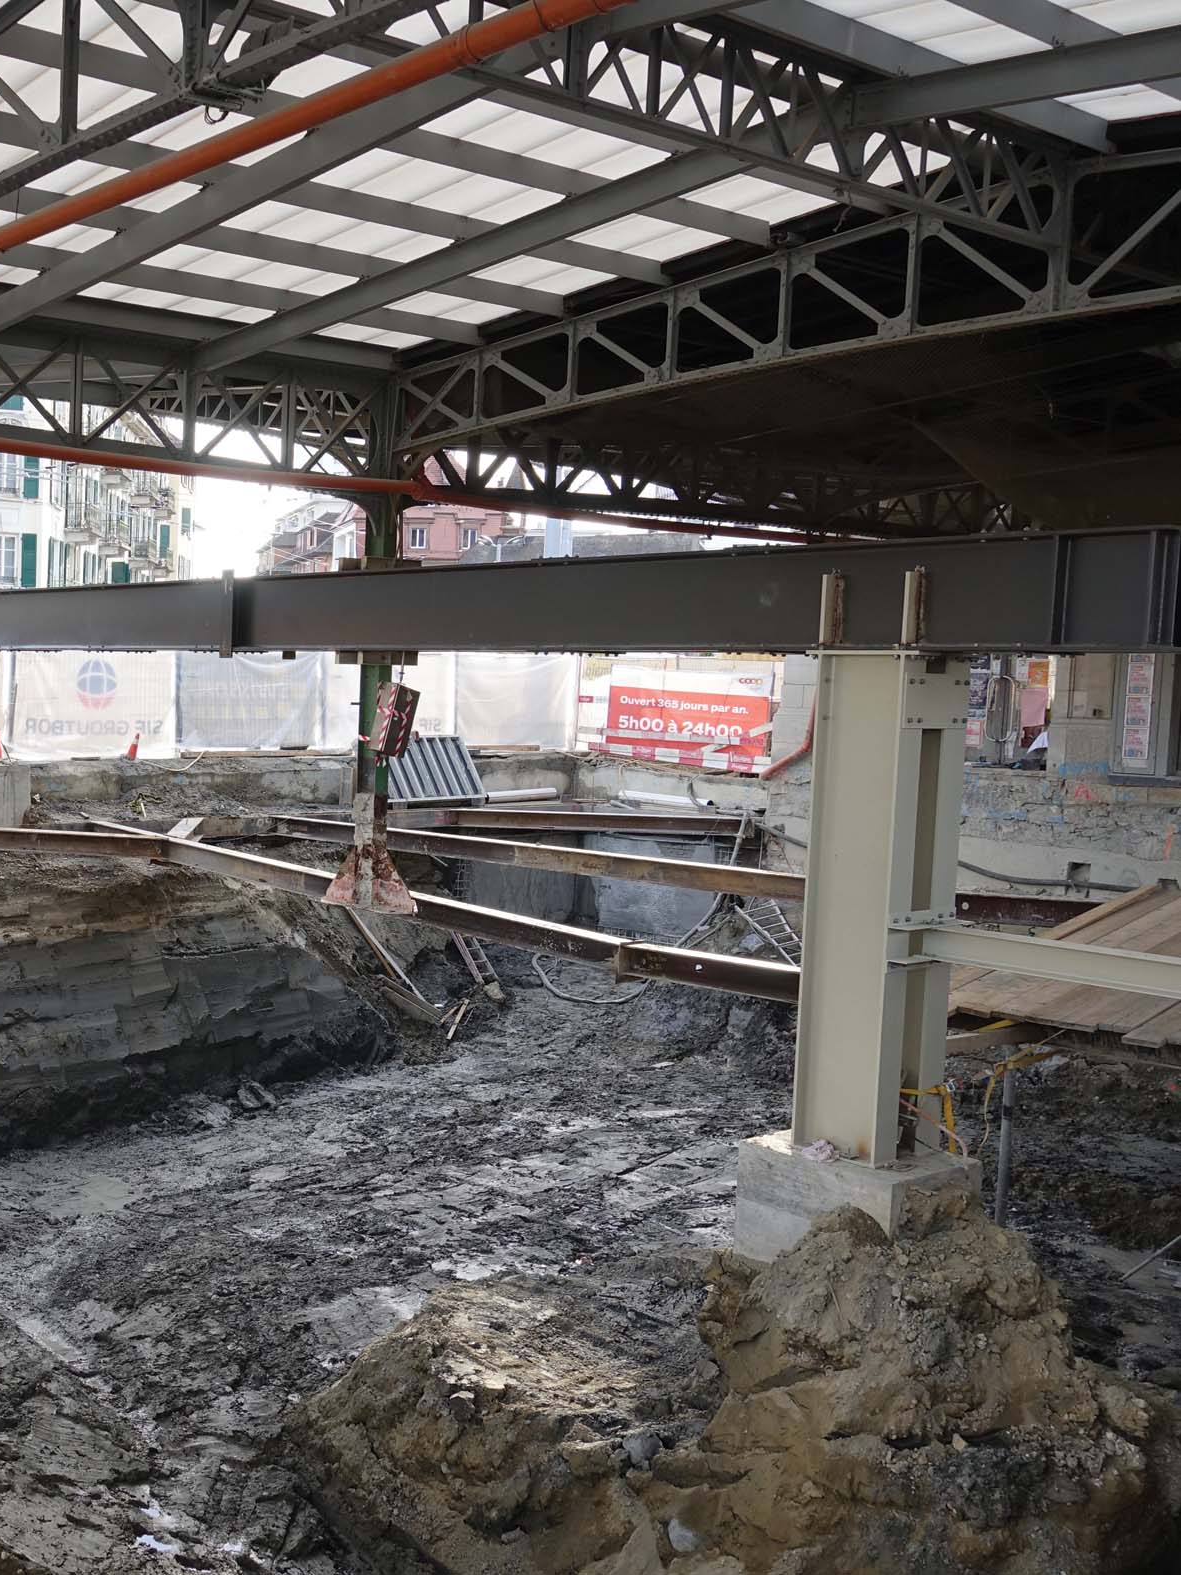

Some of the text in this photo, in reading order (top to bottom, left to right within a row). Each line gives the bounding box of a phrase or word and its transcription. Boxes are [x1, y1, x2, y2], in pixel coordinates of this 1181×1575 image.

[620, 695, 749, 715] Ouvert 365 jours par an.
[618, 715, 743, 737] 5h00 à 24h00
